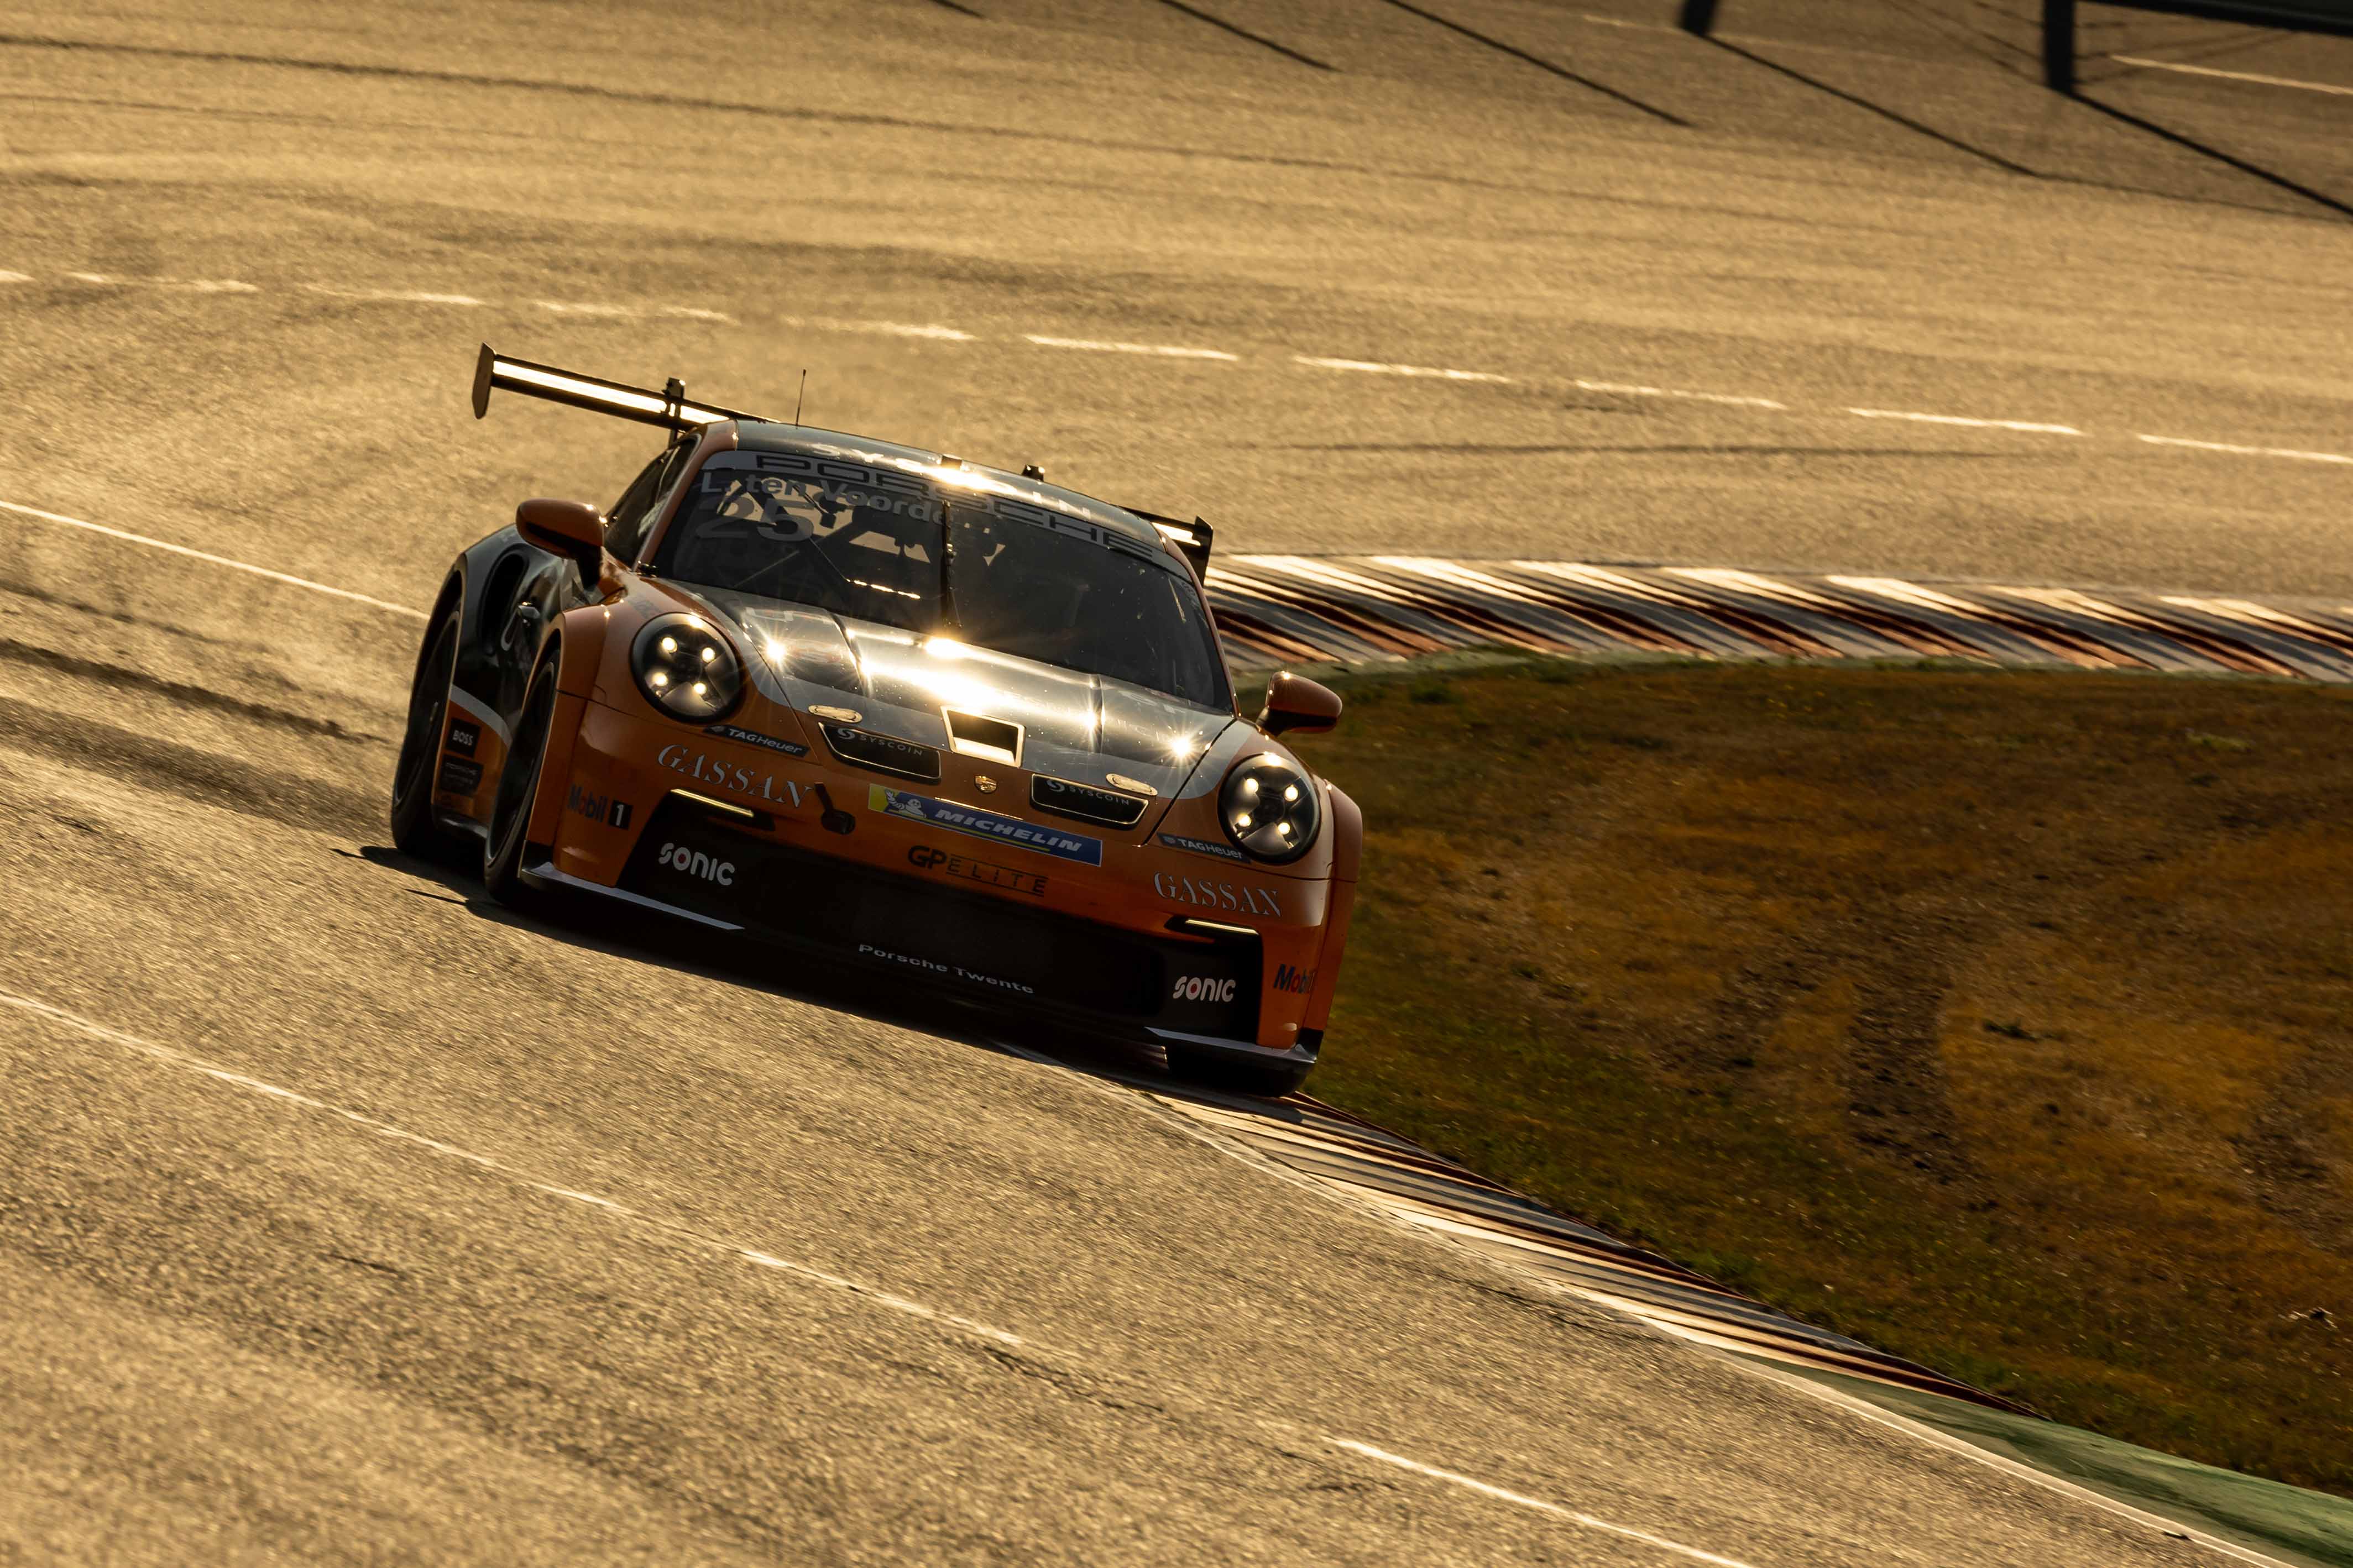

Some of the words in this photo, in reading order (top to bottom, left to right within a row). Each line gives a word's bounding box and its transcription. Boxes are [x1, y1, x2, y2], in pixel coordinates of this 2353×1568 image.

[695, 495, 814, 542] 25
[745, 474, 806, 496] ten
[819, 479, 953, 525] Voorde
[756, 455, 1153, 559] PORSCHE
[452, 729, 474, 746] BOSS
[859, 733, 924, 757] SYSCOIN
[657, 744, 814, 808] GASSAN
[1067, 785, 1130, 806] SYSCOIN
[567, 783, 608, 822] Mobil
[615, 803, 625, 827] 1
[934, 809, 1083, 852] MICHELIN
[1154, 871, 1282, 917] GASSAN
[858, 943, 948, 972] Porsche
[953, 966, 1034, 994] Twente
